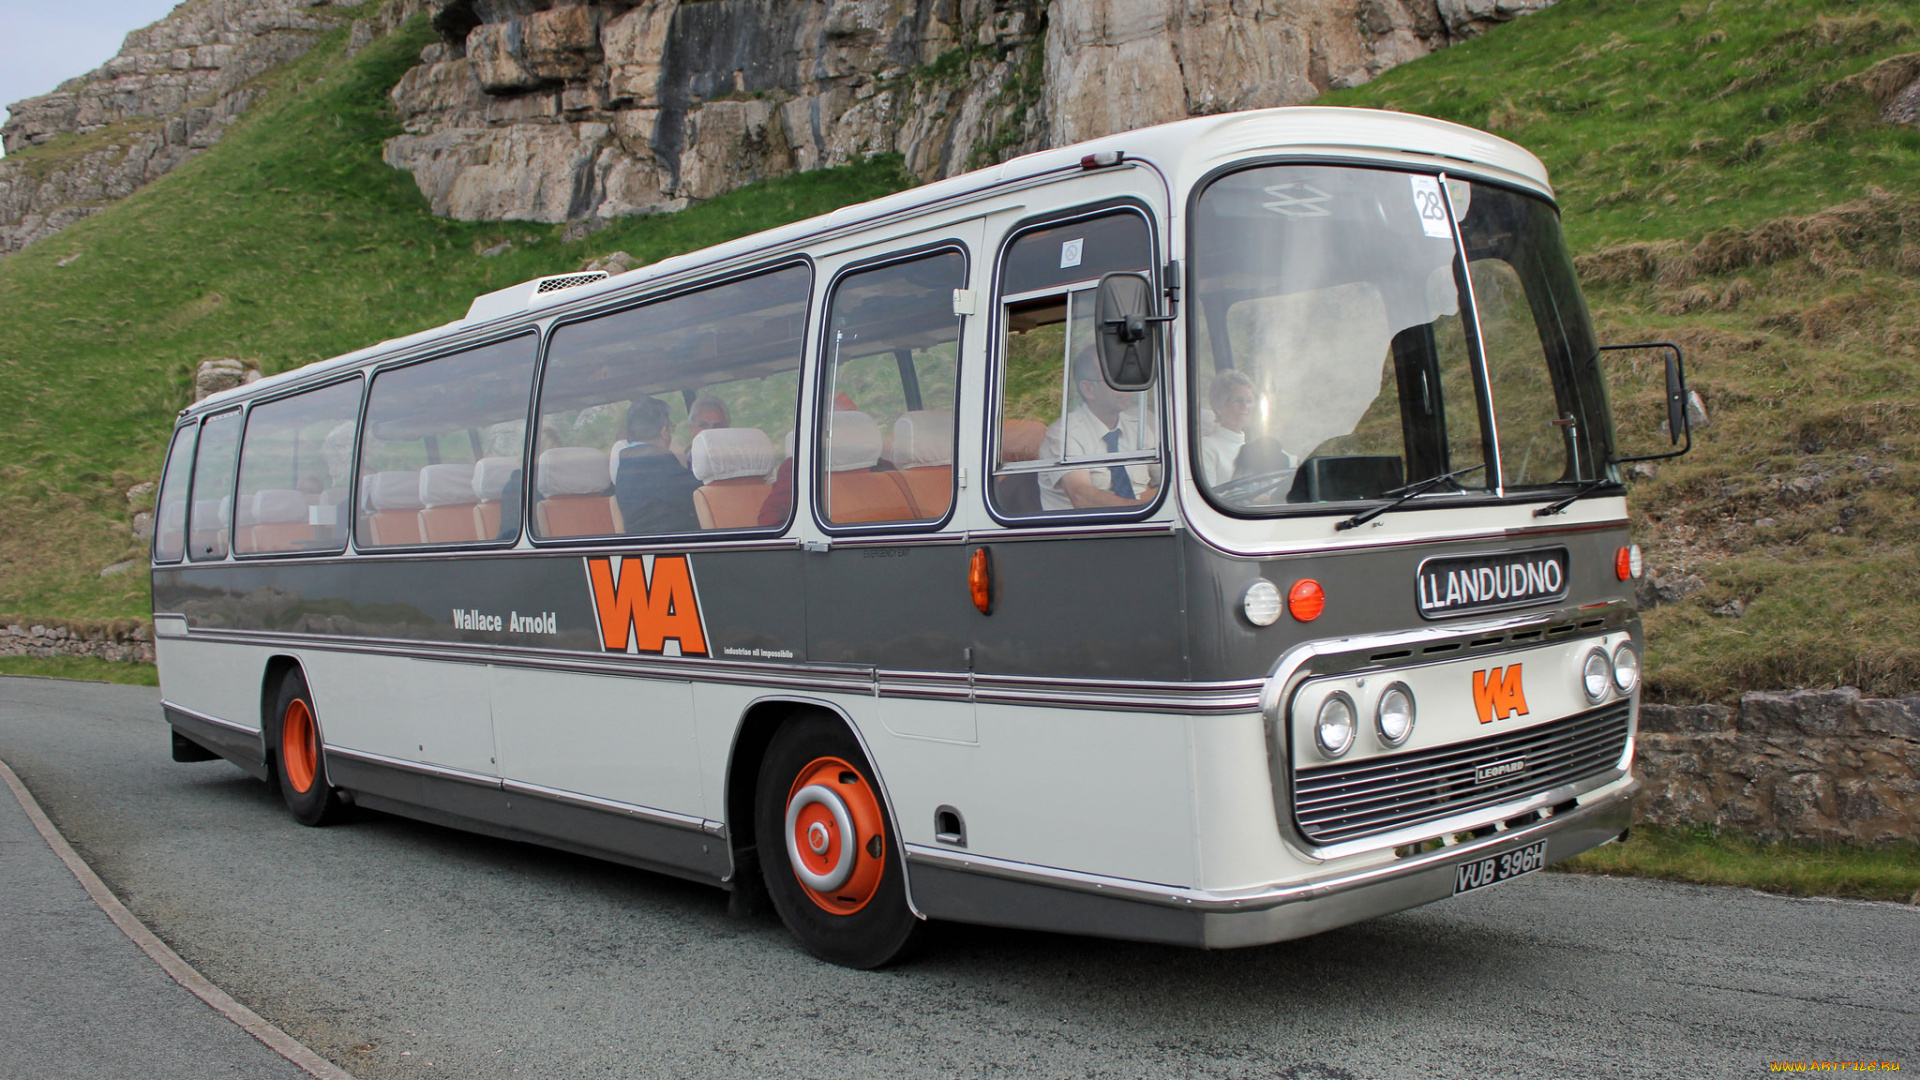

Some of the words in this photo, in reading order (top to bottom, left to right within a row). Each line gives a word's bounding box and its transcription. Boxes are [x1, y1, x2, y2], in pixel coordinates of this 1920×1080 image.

[1416, 189, 1445, 221] 28
[1420, 559, 1561, 609] LLANDUDNO
[453, 608, 502, 632] Wallace
[509, 610, 557, 635] Arnold
[585, 553, 710, 658] WA
[752, 648, 760, 657] nil
[1472, 662, 1530, 724] WA
[1478, 760, 1525, 780] LEOPARD
[1459, 858, 1496, 892] VUB
[1499, 842, 1545, 880] 396H
